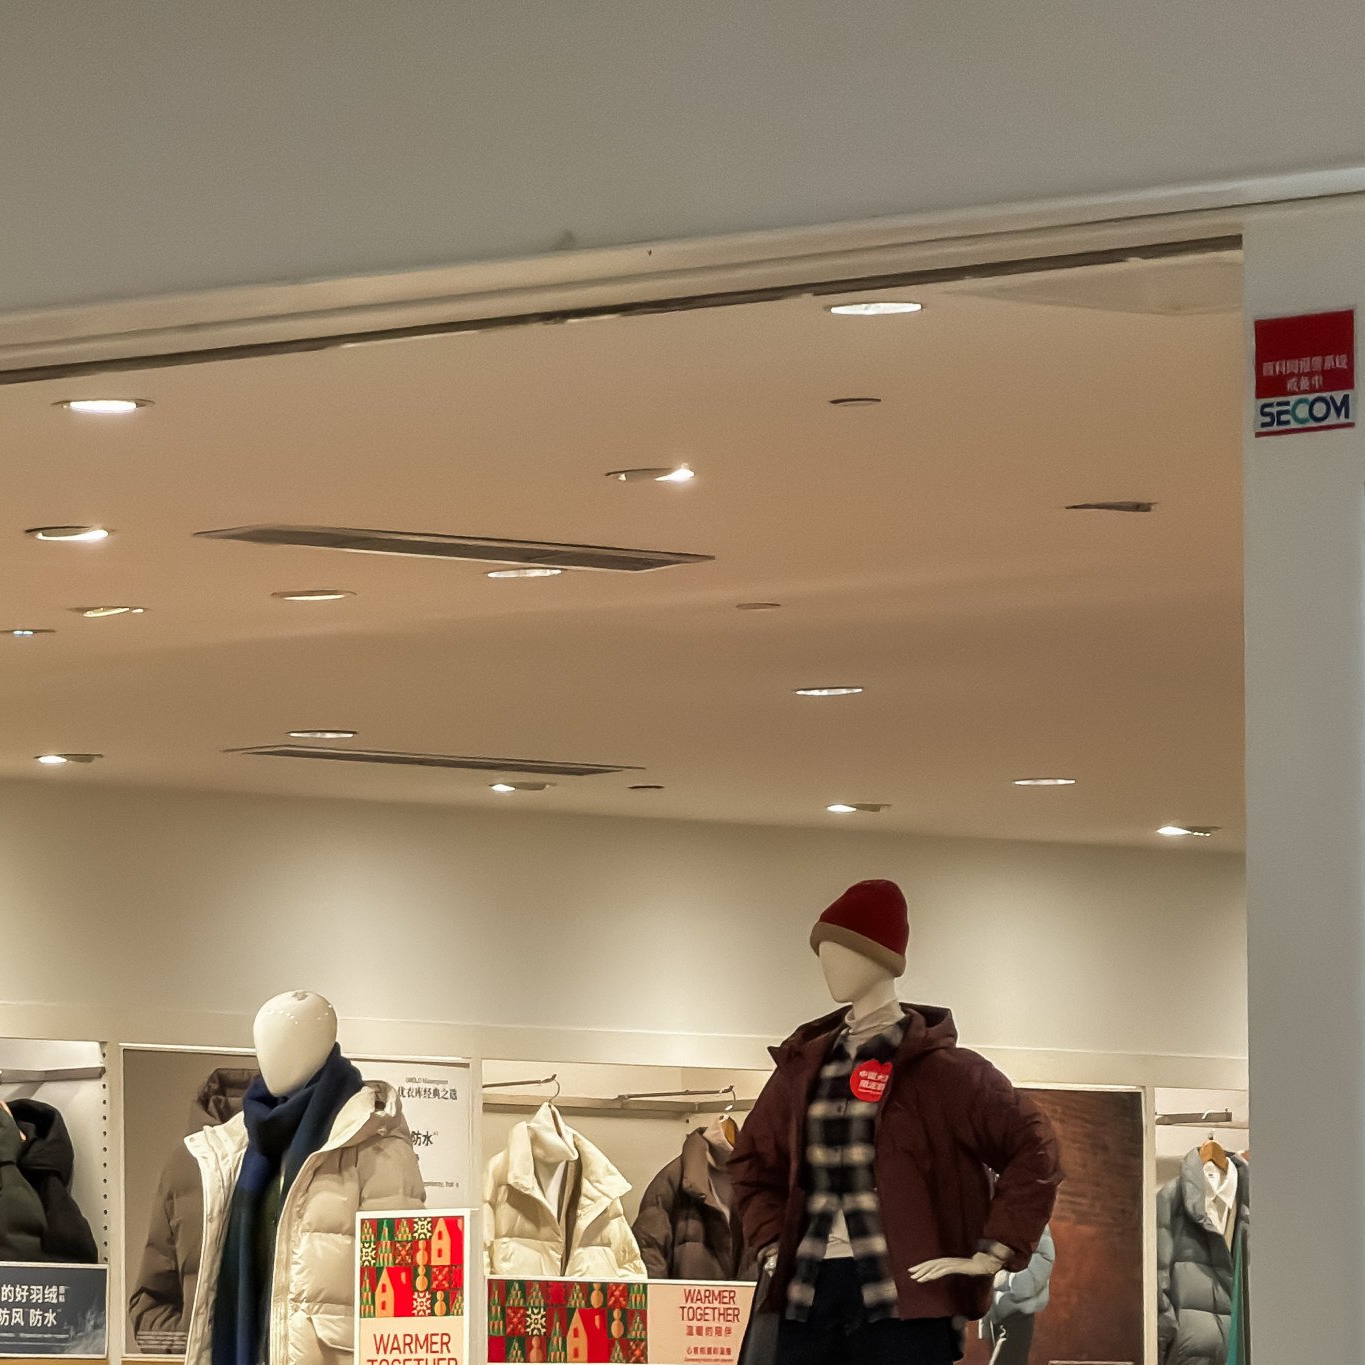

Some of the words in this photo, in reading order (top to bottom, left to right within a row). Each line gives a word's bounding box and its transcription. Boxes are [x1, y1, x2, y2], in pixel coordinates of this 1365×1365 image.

[1260, 394, 1349, 428] SECOM
[683, 1288, 737, 1304] WARMER
[679, 1306, 740, 1322] TOGETHER
[373, 1332, 451, 1355] WARMER
